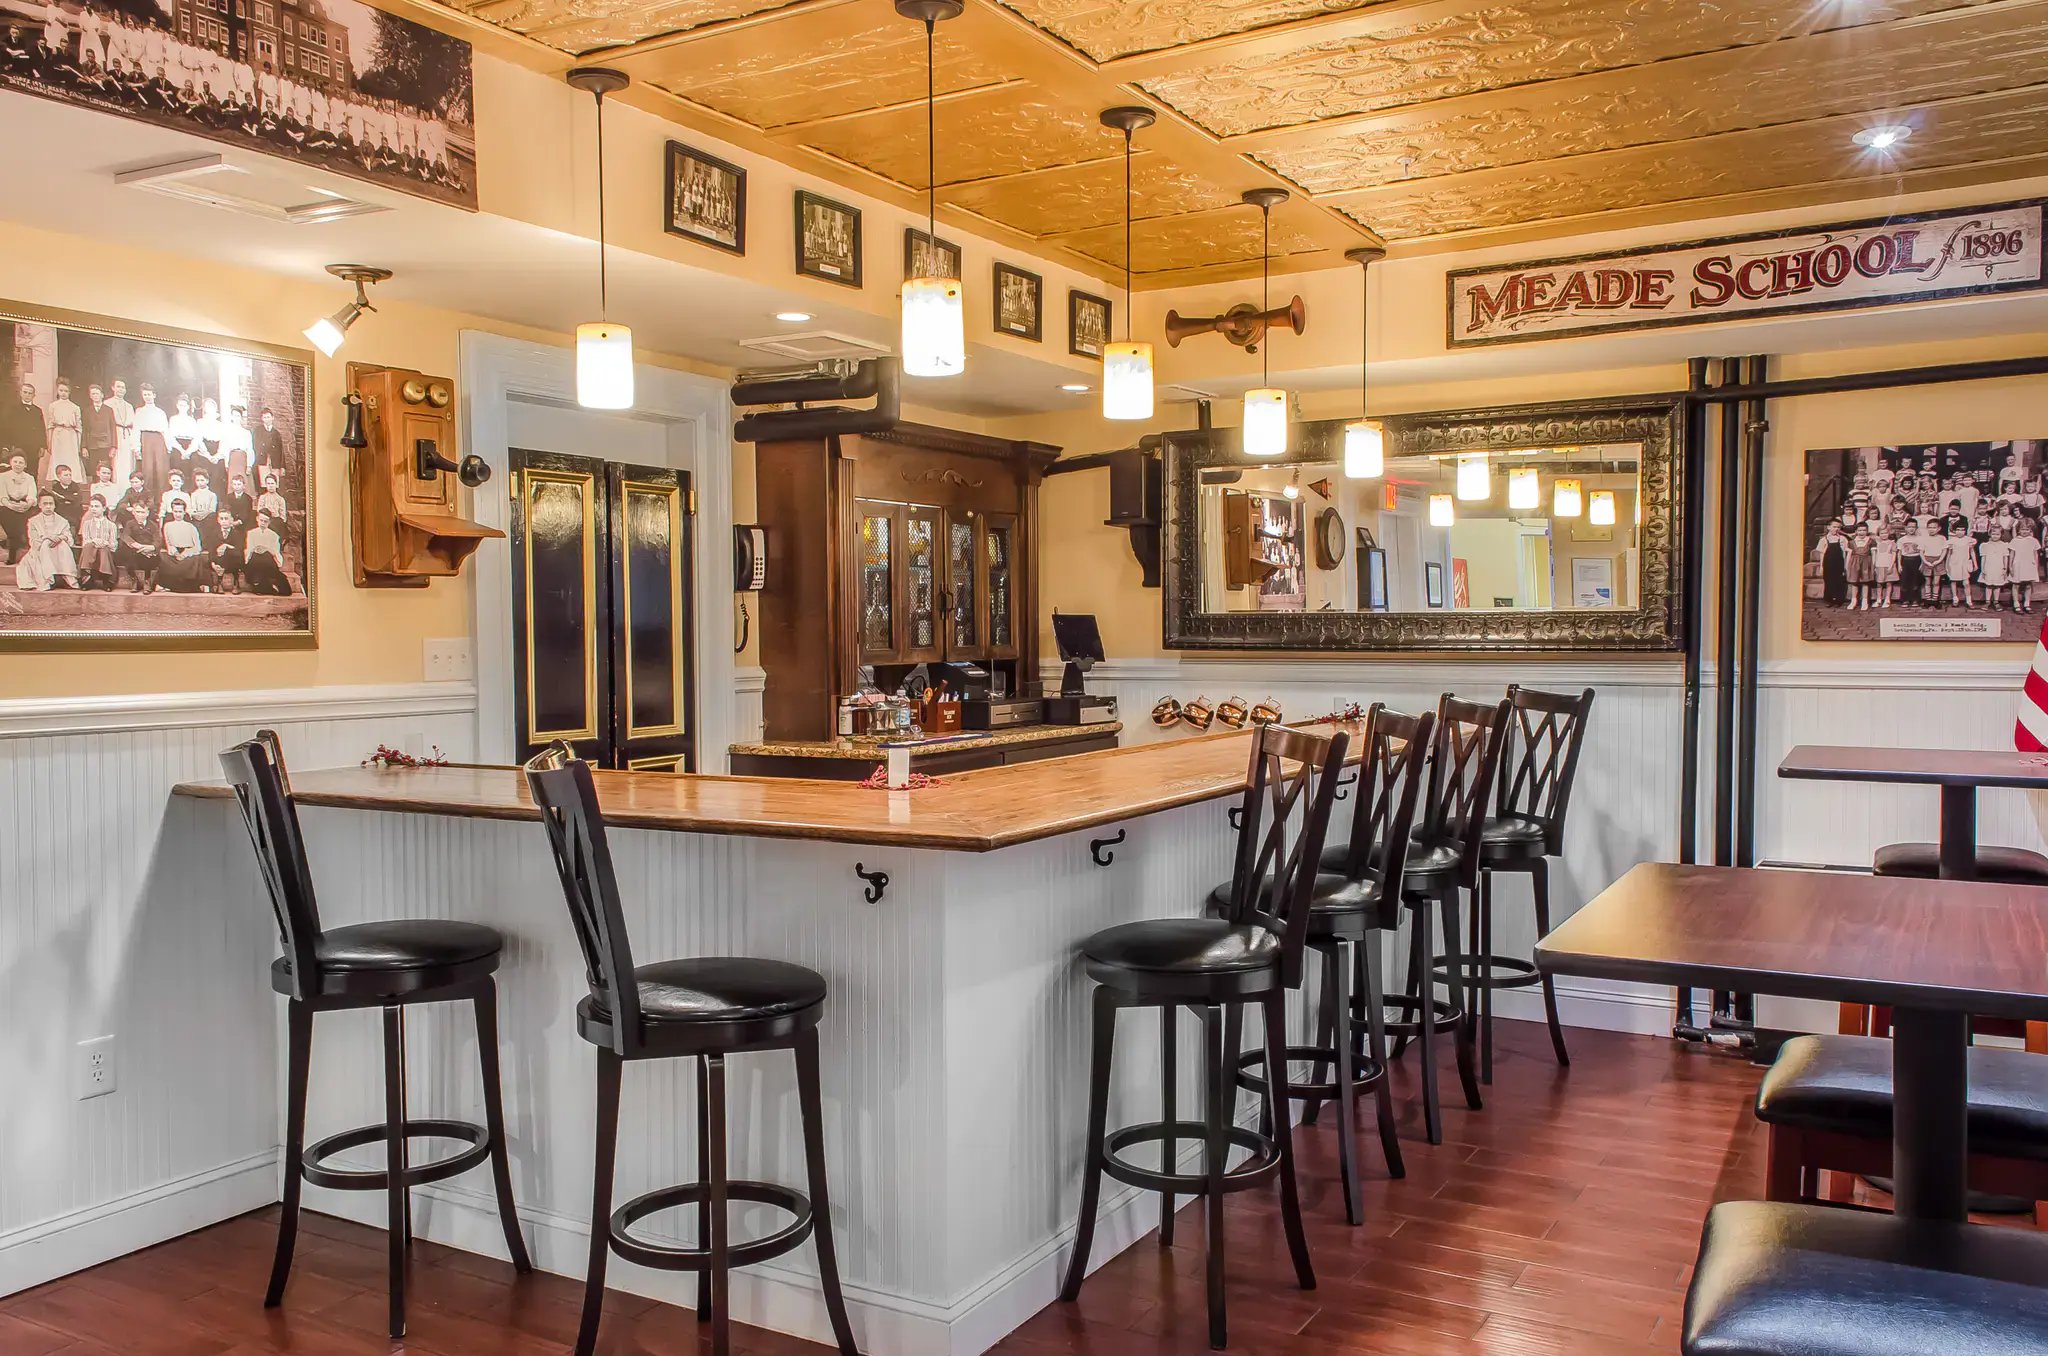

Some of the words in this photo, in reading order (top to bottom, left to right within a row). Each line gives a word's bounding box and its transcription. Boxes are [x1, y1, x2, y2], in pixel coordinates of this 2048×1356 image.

[1466, 268, 1676, 333] MEADE
[1689, 230, 1936, 309] SCHOOL
[1960, 229, 2024, 261] 1896
